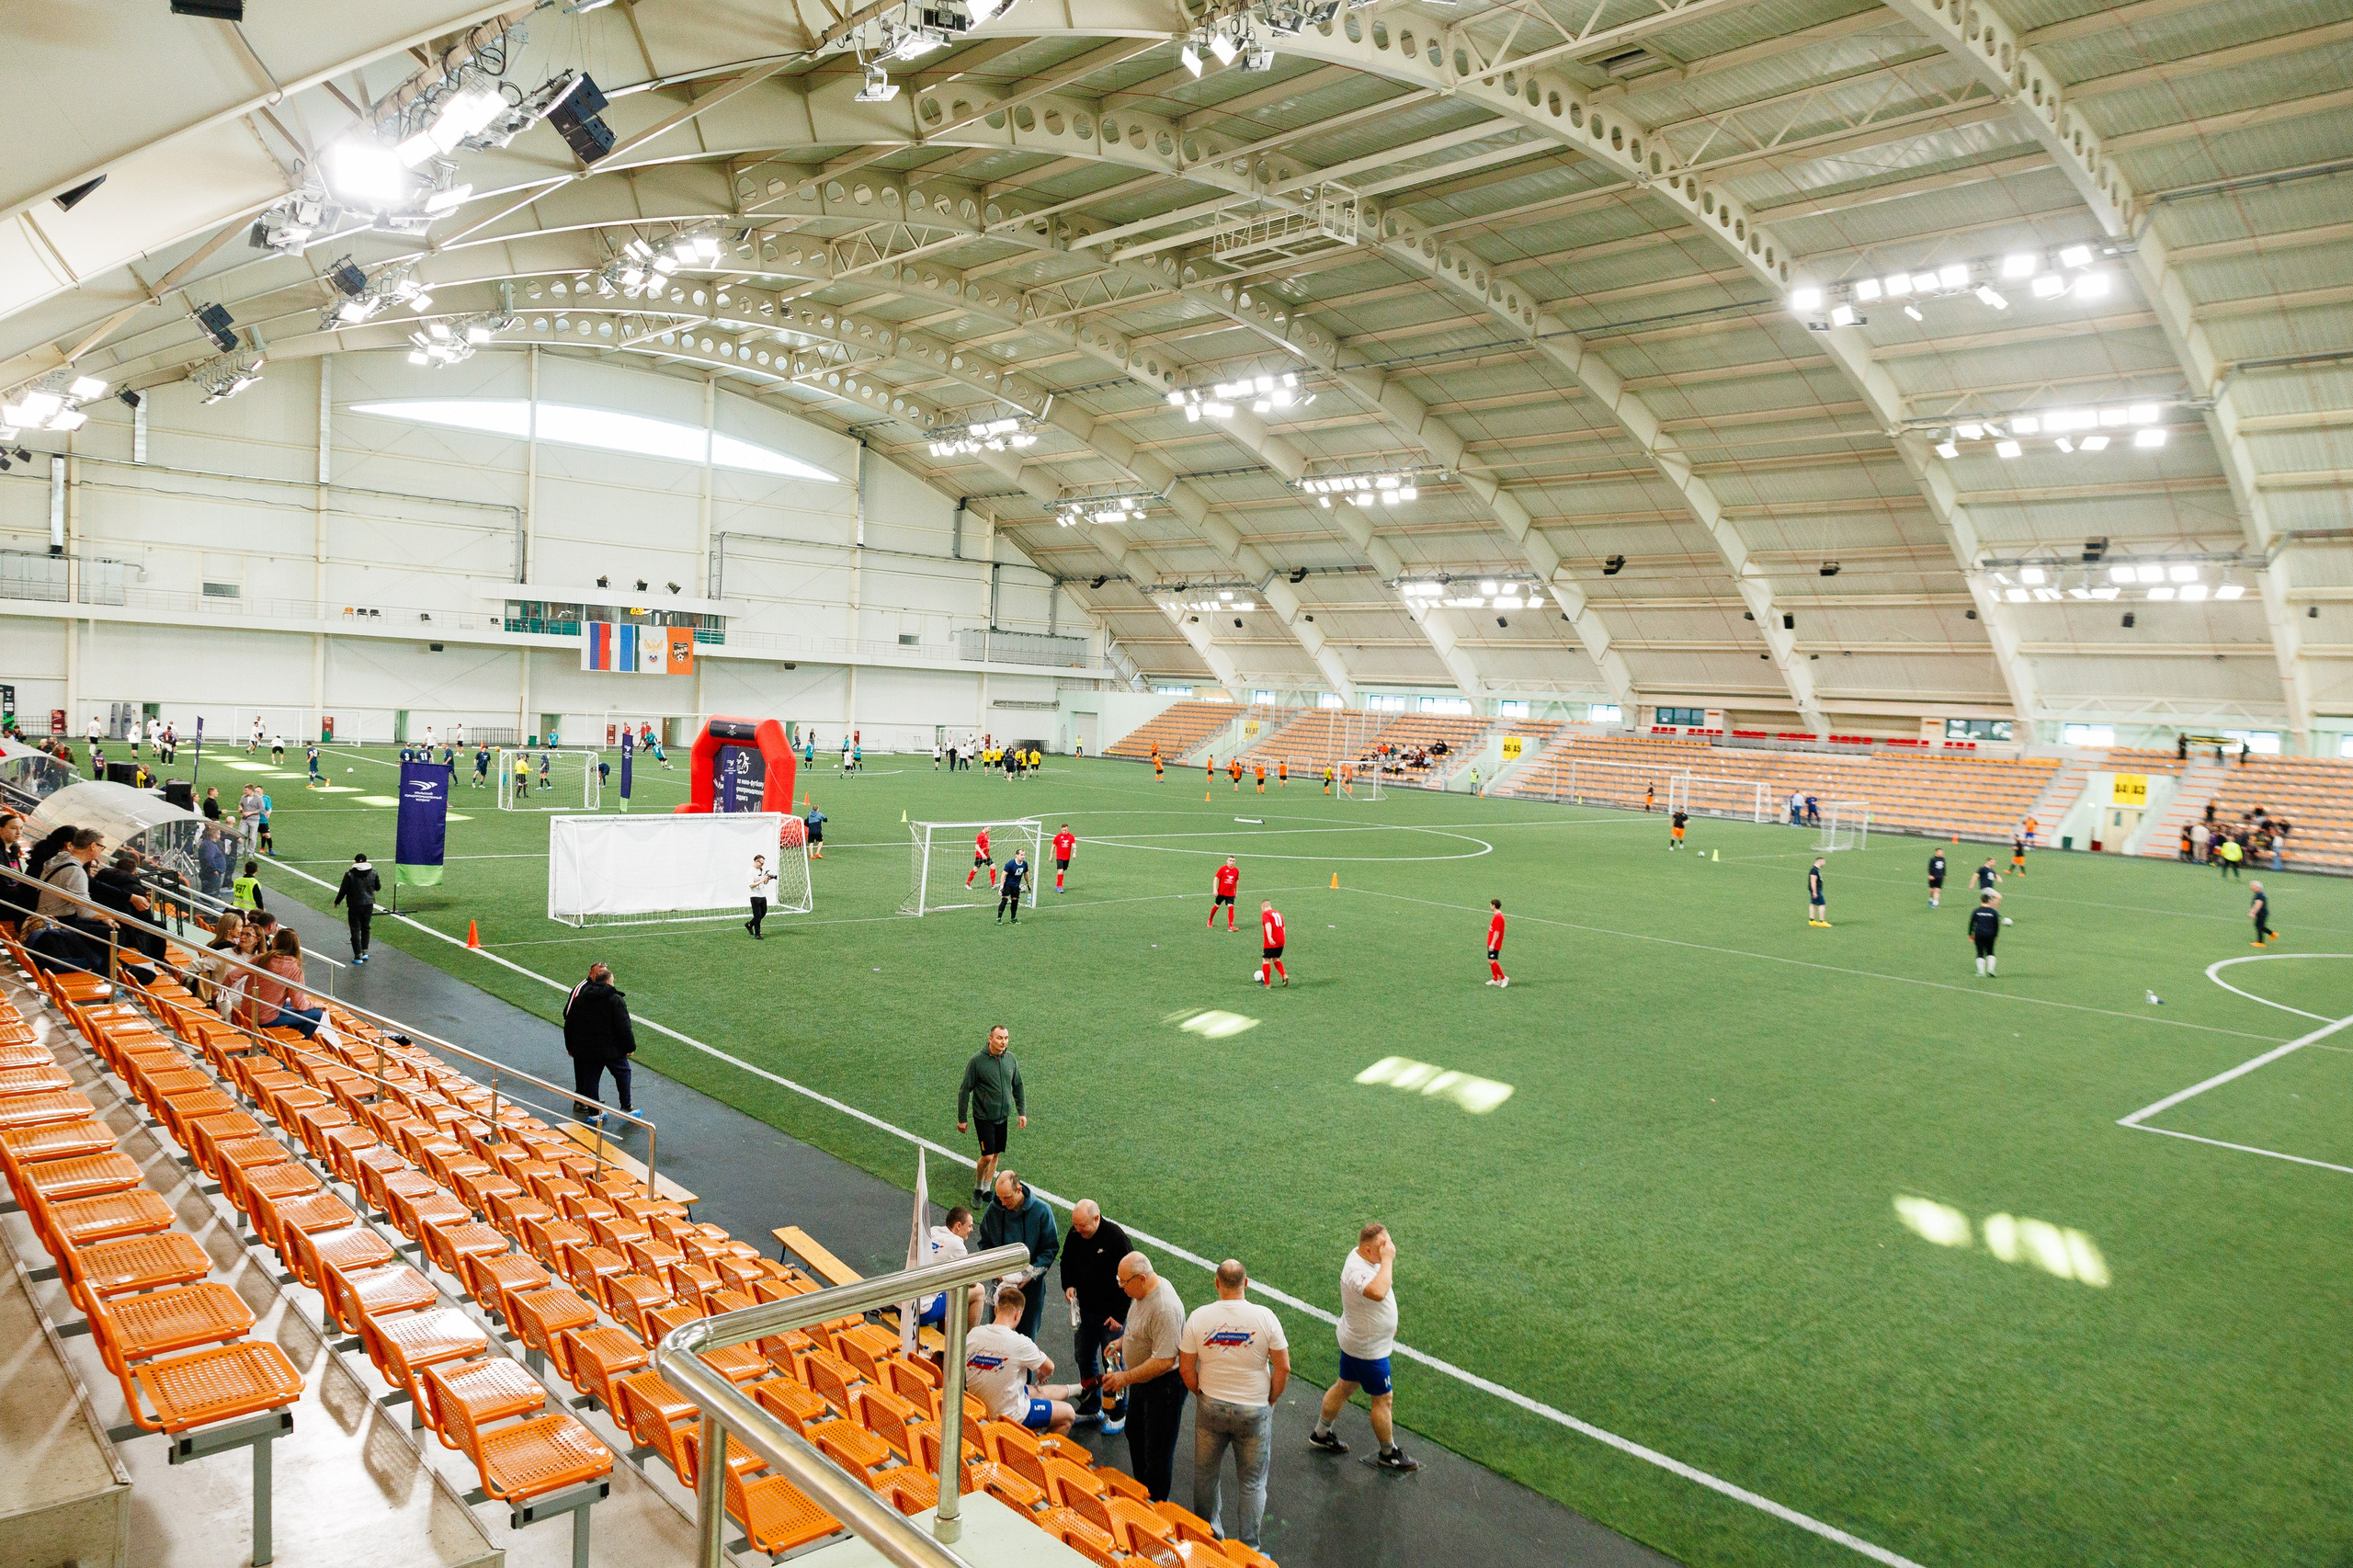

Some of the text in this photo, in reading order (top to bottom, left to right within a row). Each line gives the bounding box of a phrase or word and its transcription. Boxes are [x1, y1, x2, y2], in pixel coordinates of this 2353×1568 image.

[404, 752, 410, 761] 3
[419, 752, 427, 761] 11
[1271, 912, 1283, 927] 11
